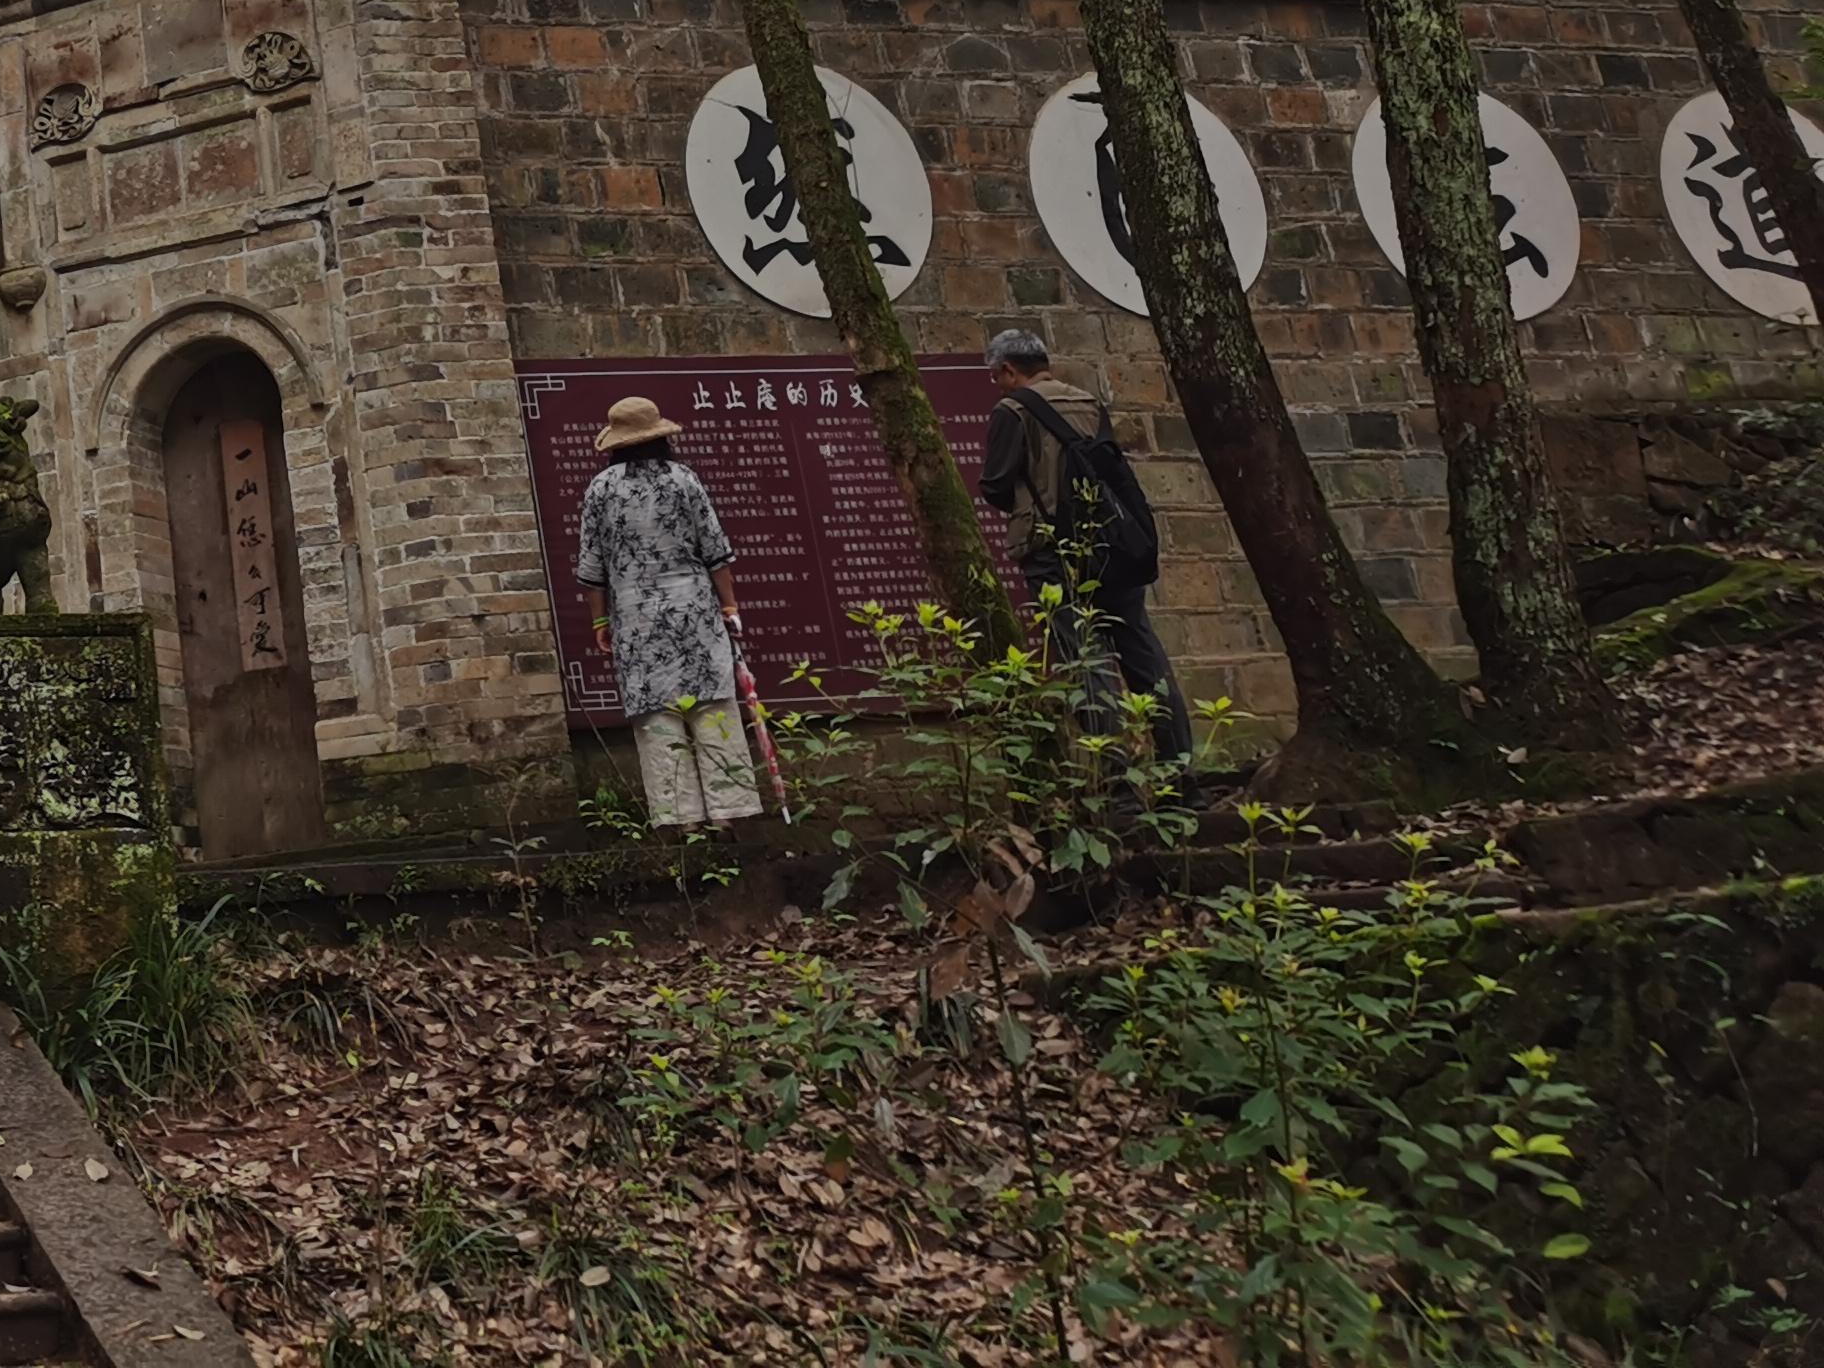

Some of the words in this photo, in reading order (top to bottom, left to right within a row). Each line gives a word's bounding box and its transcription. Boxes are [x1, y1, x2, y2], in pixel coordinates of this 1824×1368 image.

[692, 378, 871, 411] 止止庵的历史
